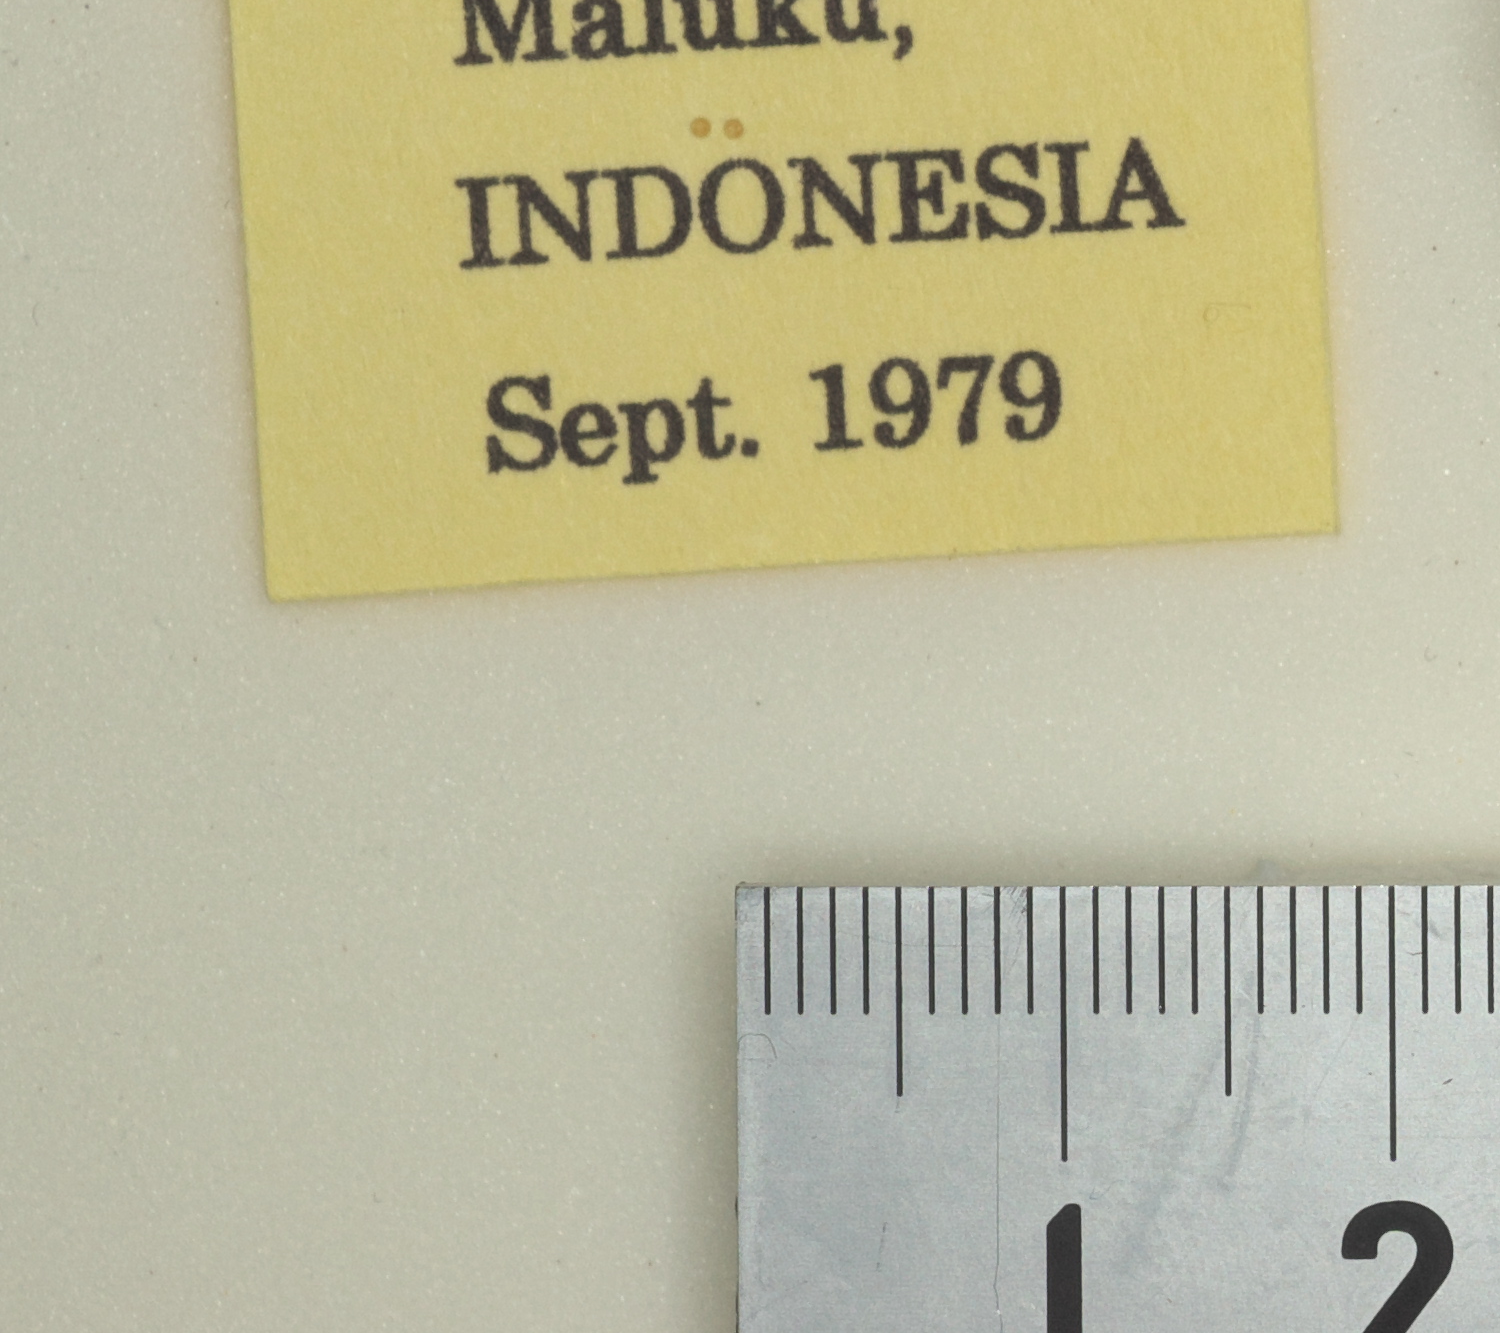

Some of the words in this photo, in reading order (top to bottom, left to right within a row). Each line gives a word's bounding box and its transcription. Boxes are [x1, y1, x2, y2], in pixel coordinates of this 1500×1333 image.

[454, 137, 1187, 271] INDONESIA
[485, 373, 762, 486] Sept.
[808, 349, 1063, 452] 1979
[1340, 1199, 1455, 1333] 2
